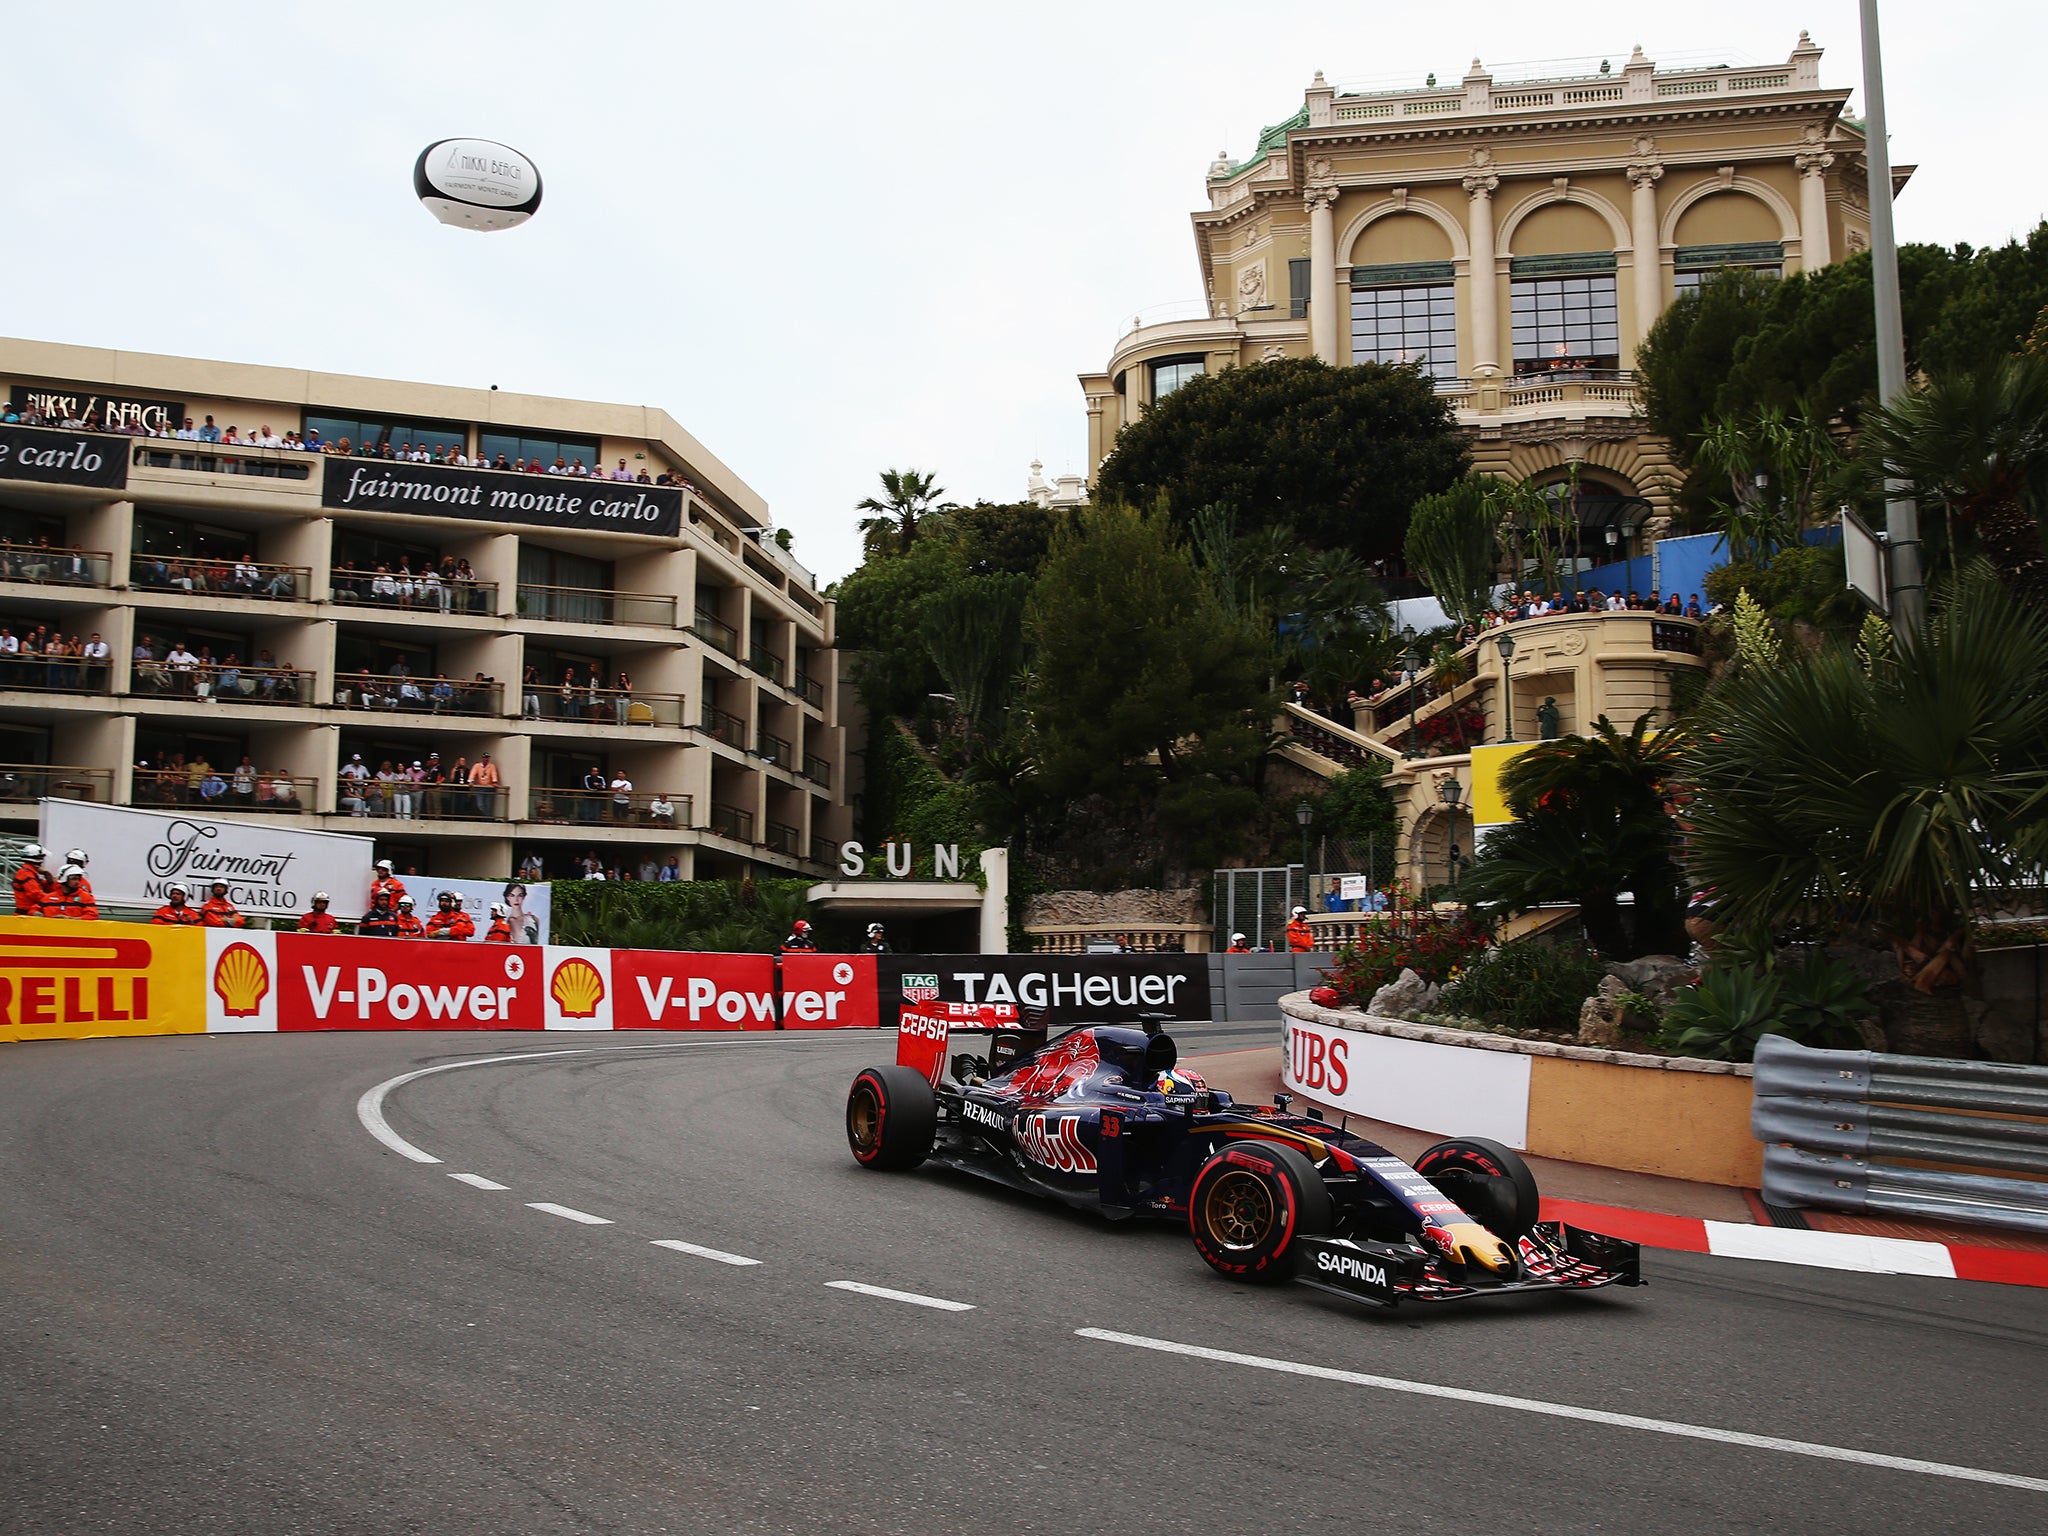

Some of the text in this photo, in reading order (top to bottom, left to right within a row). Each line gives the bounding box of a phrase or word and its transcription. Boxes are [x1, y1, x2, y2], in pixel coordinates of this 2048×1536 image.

[461, 155, 522, 180] NIKKI BEACH
[18, 441, 103, 472] carlo
[342, 467, 661, 522] fairmont monte carlo
[147, 820, 298, 886] Fairmont
[143, 879, 298, 909] MONT CARLO
[301, 965, 517, 1020] V-Power
[903, 988, 939, 1002] HEUER
[905, 976, 936, 987] TAG
[635, 976, 846, 1022] V-Power
[900, 1012, 948, 1042] CEPSA
[1292, 1027, 1349, 1096] UBS
[962, 1100, 1005, 1131] RENAULT
[1165, 1096, 1195, 1105] SAPINDA
[1101, 1115, 1120, 1138] 33
[1442, 1149, 1458, 1160] P
[1317, 1251, 1387, 1288] SAPINDA
